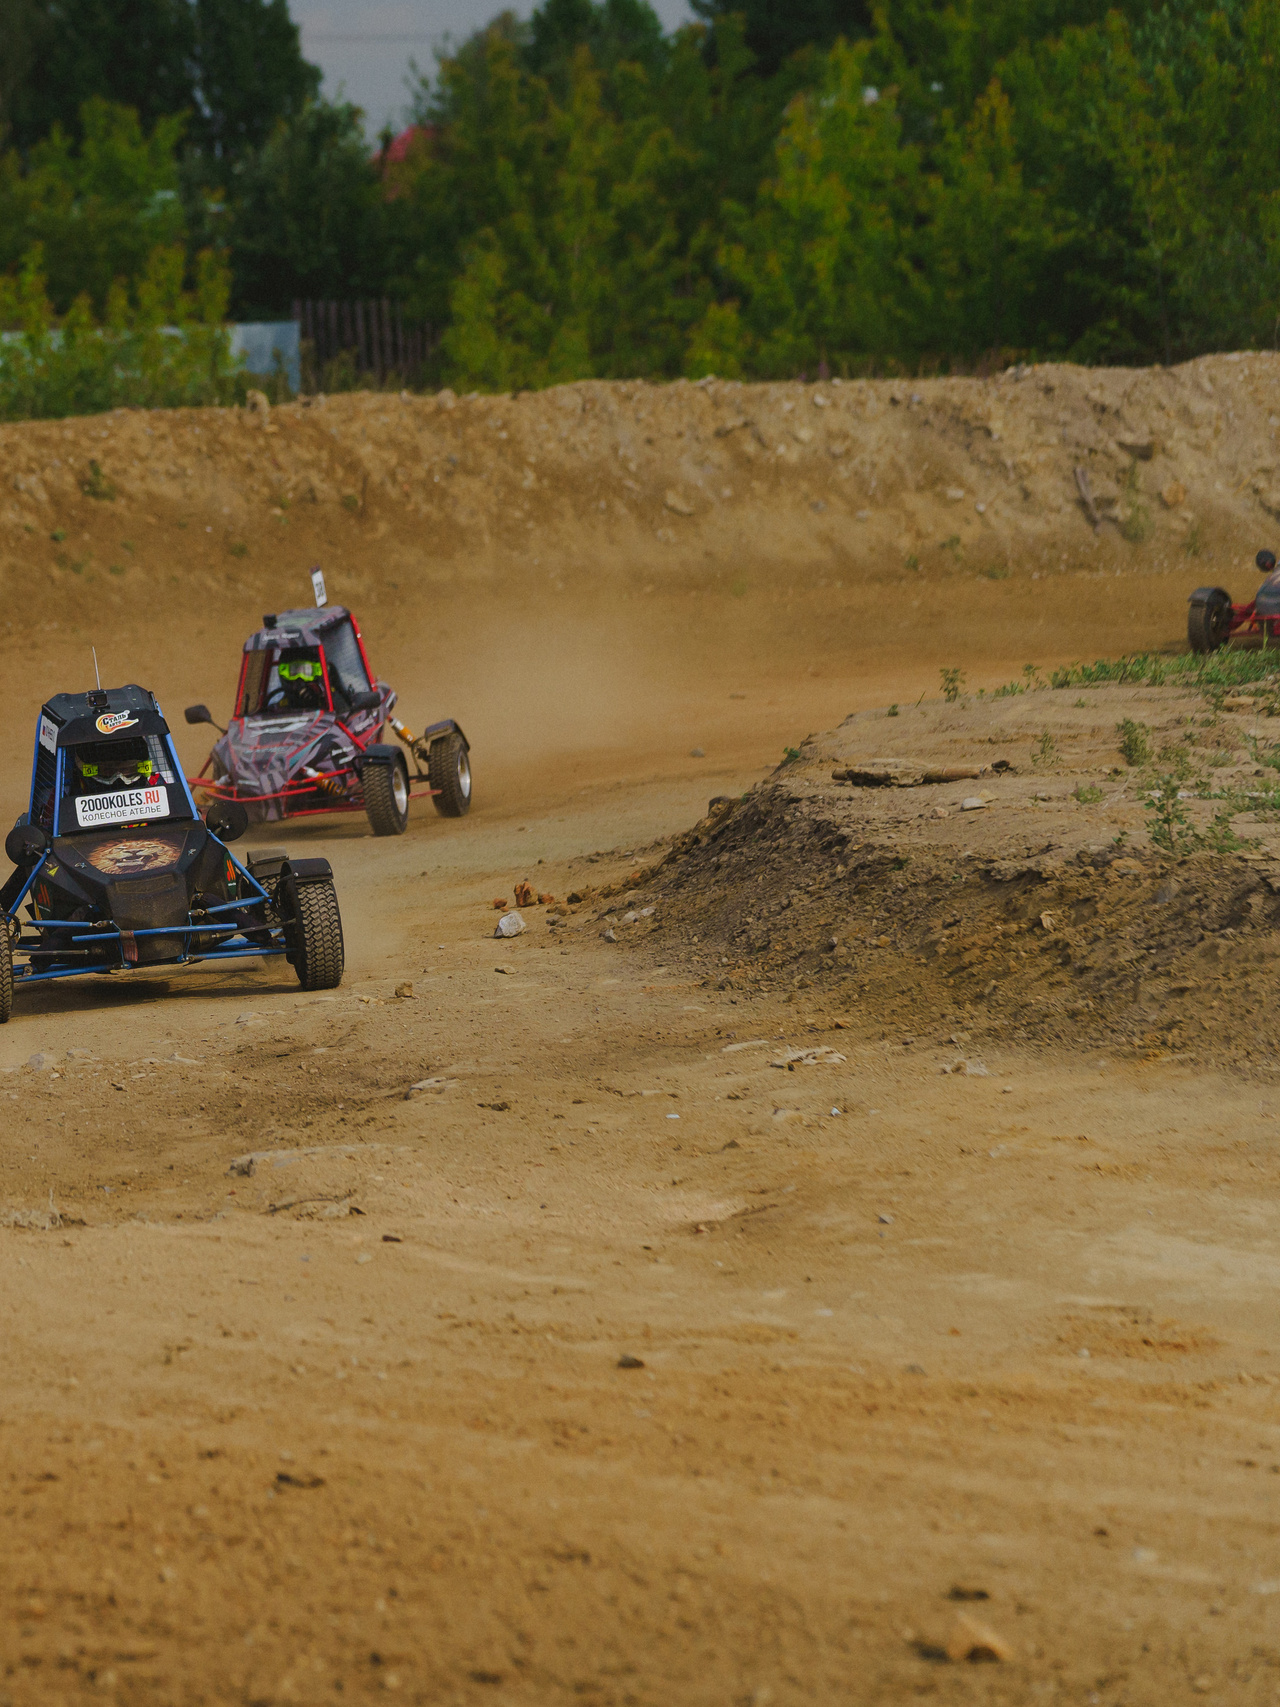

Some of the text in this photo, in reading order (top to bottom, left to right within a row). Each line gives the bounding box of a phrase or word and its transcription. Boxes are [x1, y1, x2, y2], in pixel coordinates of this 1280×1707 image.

[80, 789, 160, 813] 2000KOLES.RU
[82, 805, 162, 822] КОЛЕСНОЕ АТЕЛЬЕ
